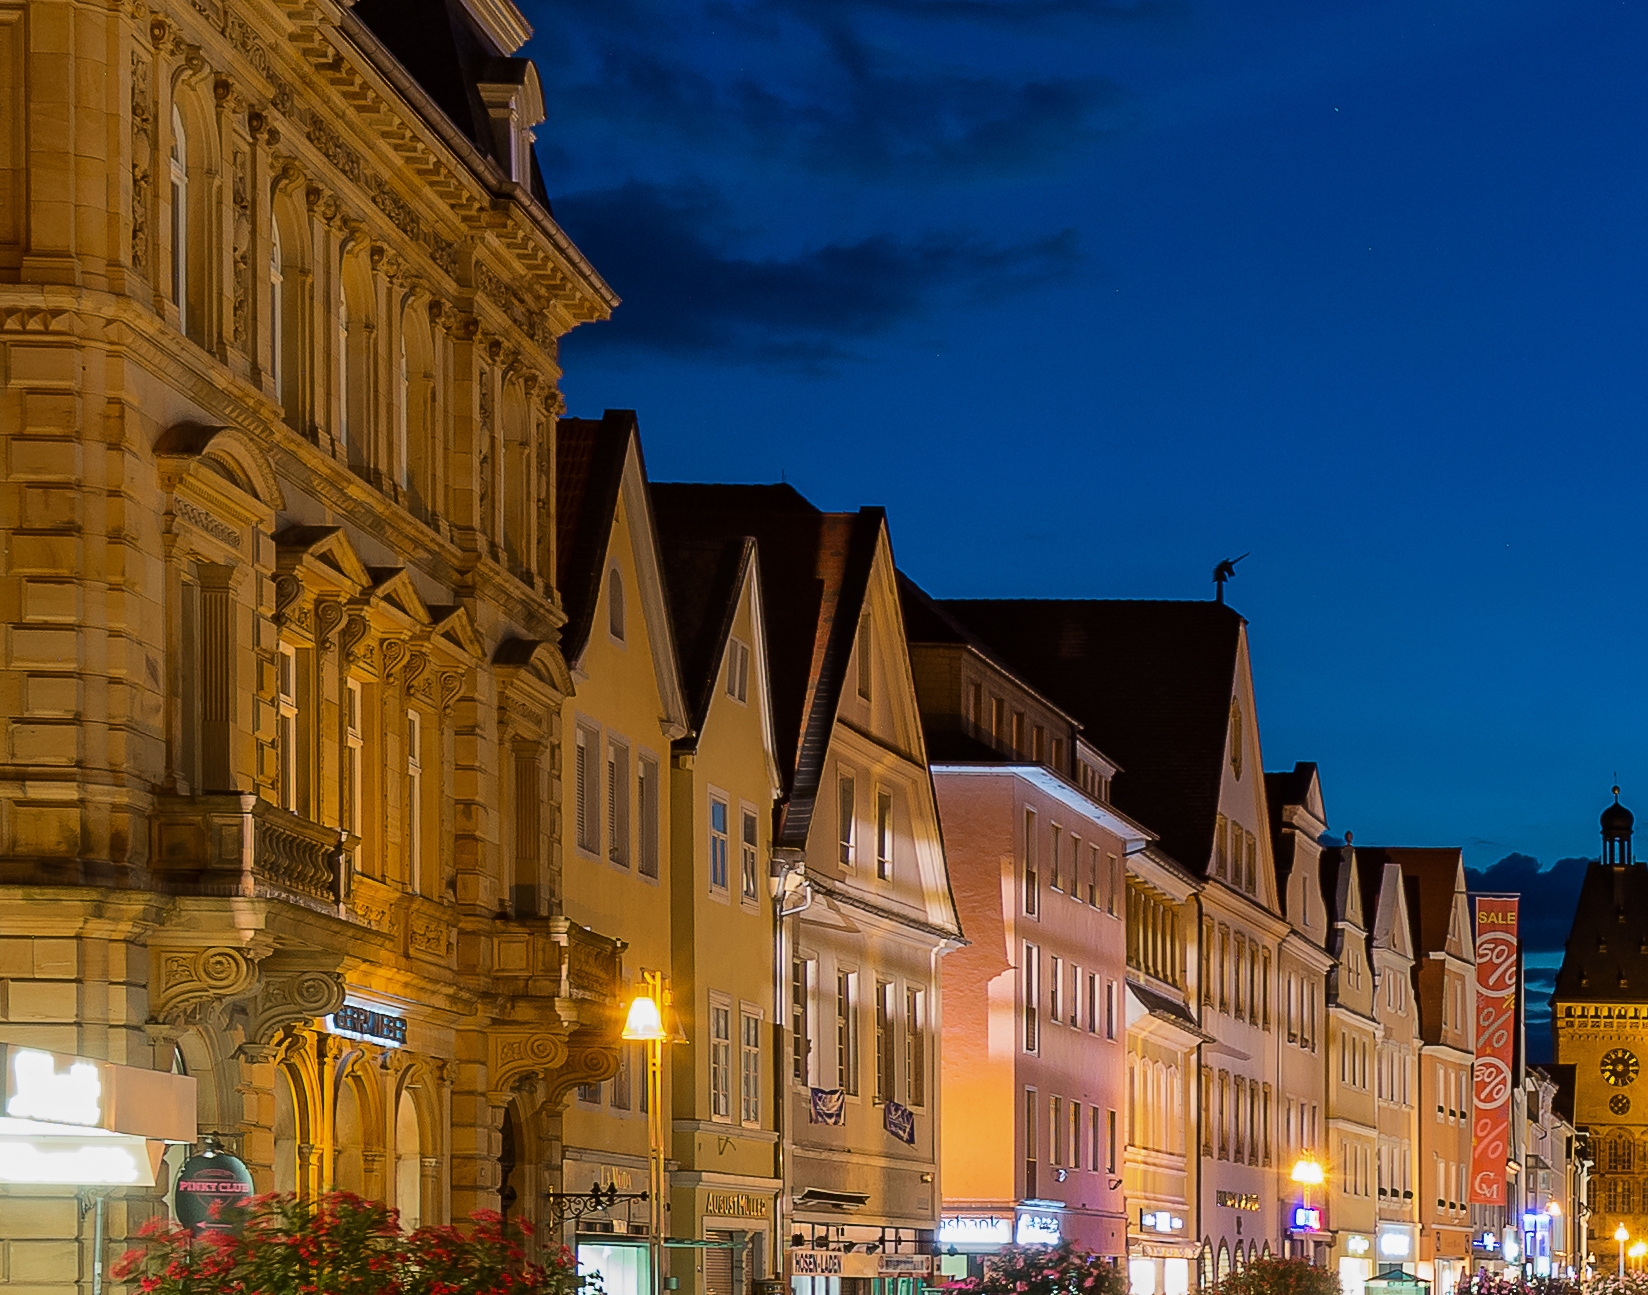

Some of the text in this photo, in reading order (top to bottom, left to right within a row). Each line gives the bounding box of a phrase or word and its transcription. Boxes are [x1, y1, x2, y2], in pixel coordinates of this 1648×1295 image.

[1478, 911, 1516, 924] SALE
[1476, 943, 1516, 985] 50%
[179, 1181, 250, 1193] PINKY CLUB
